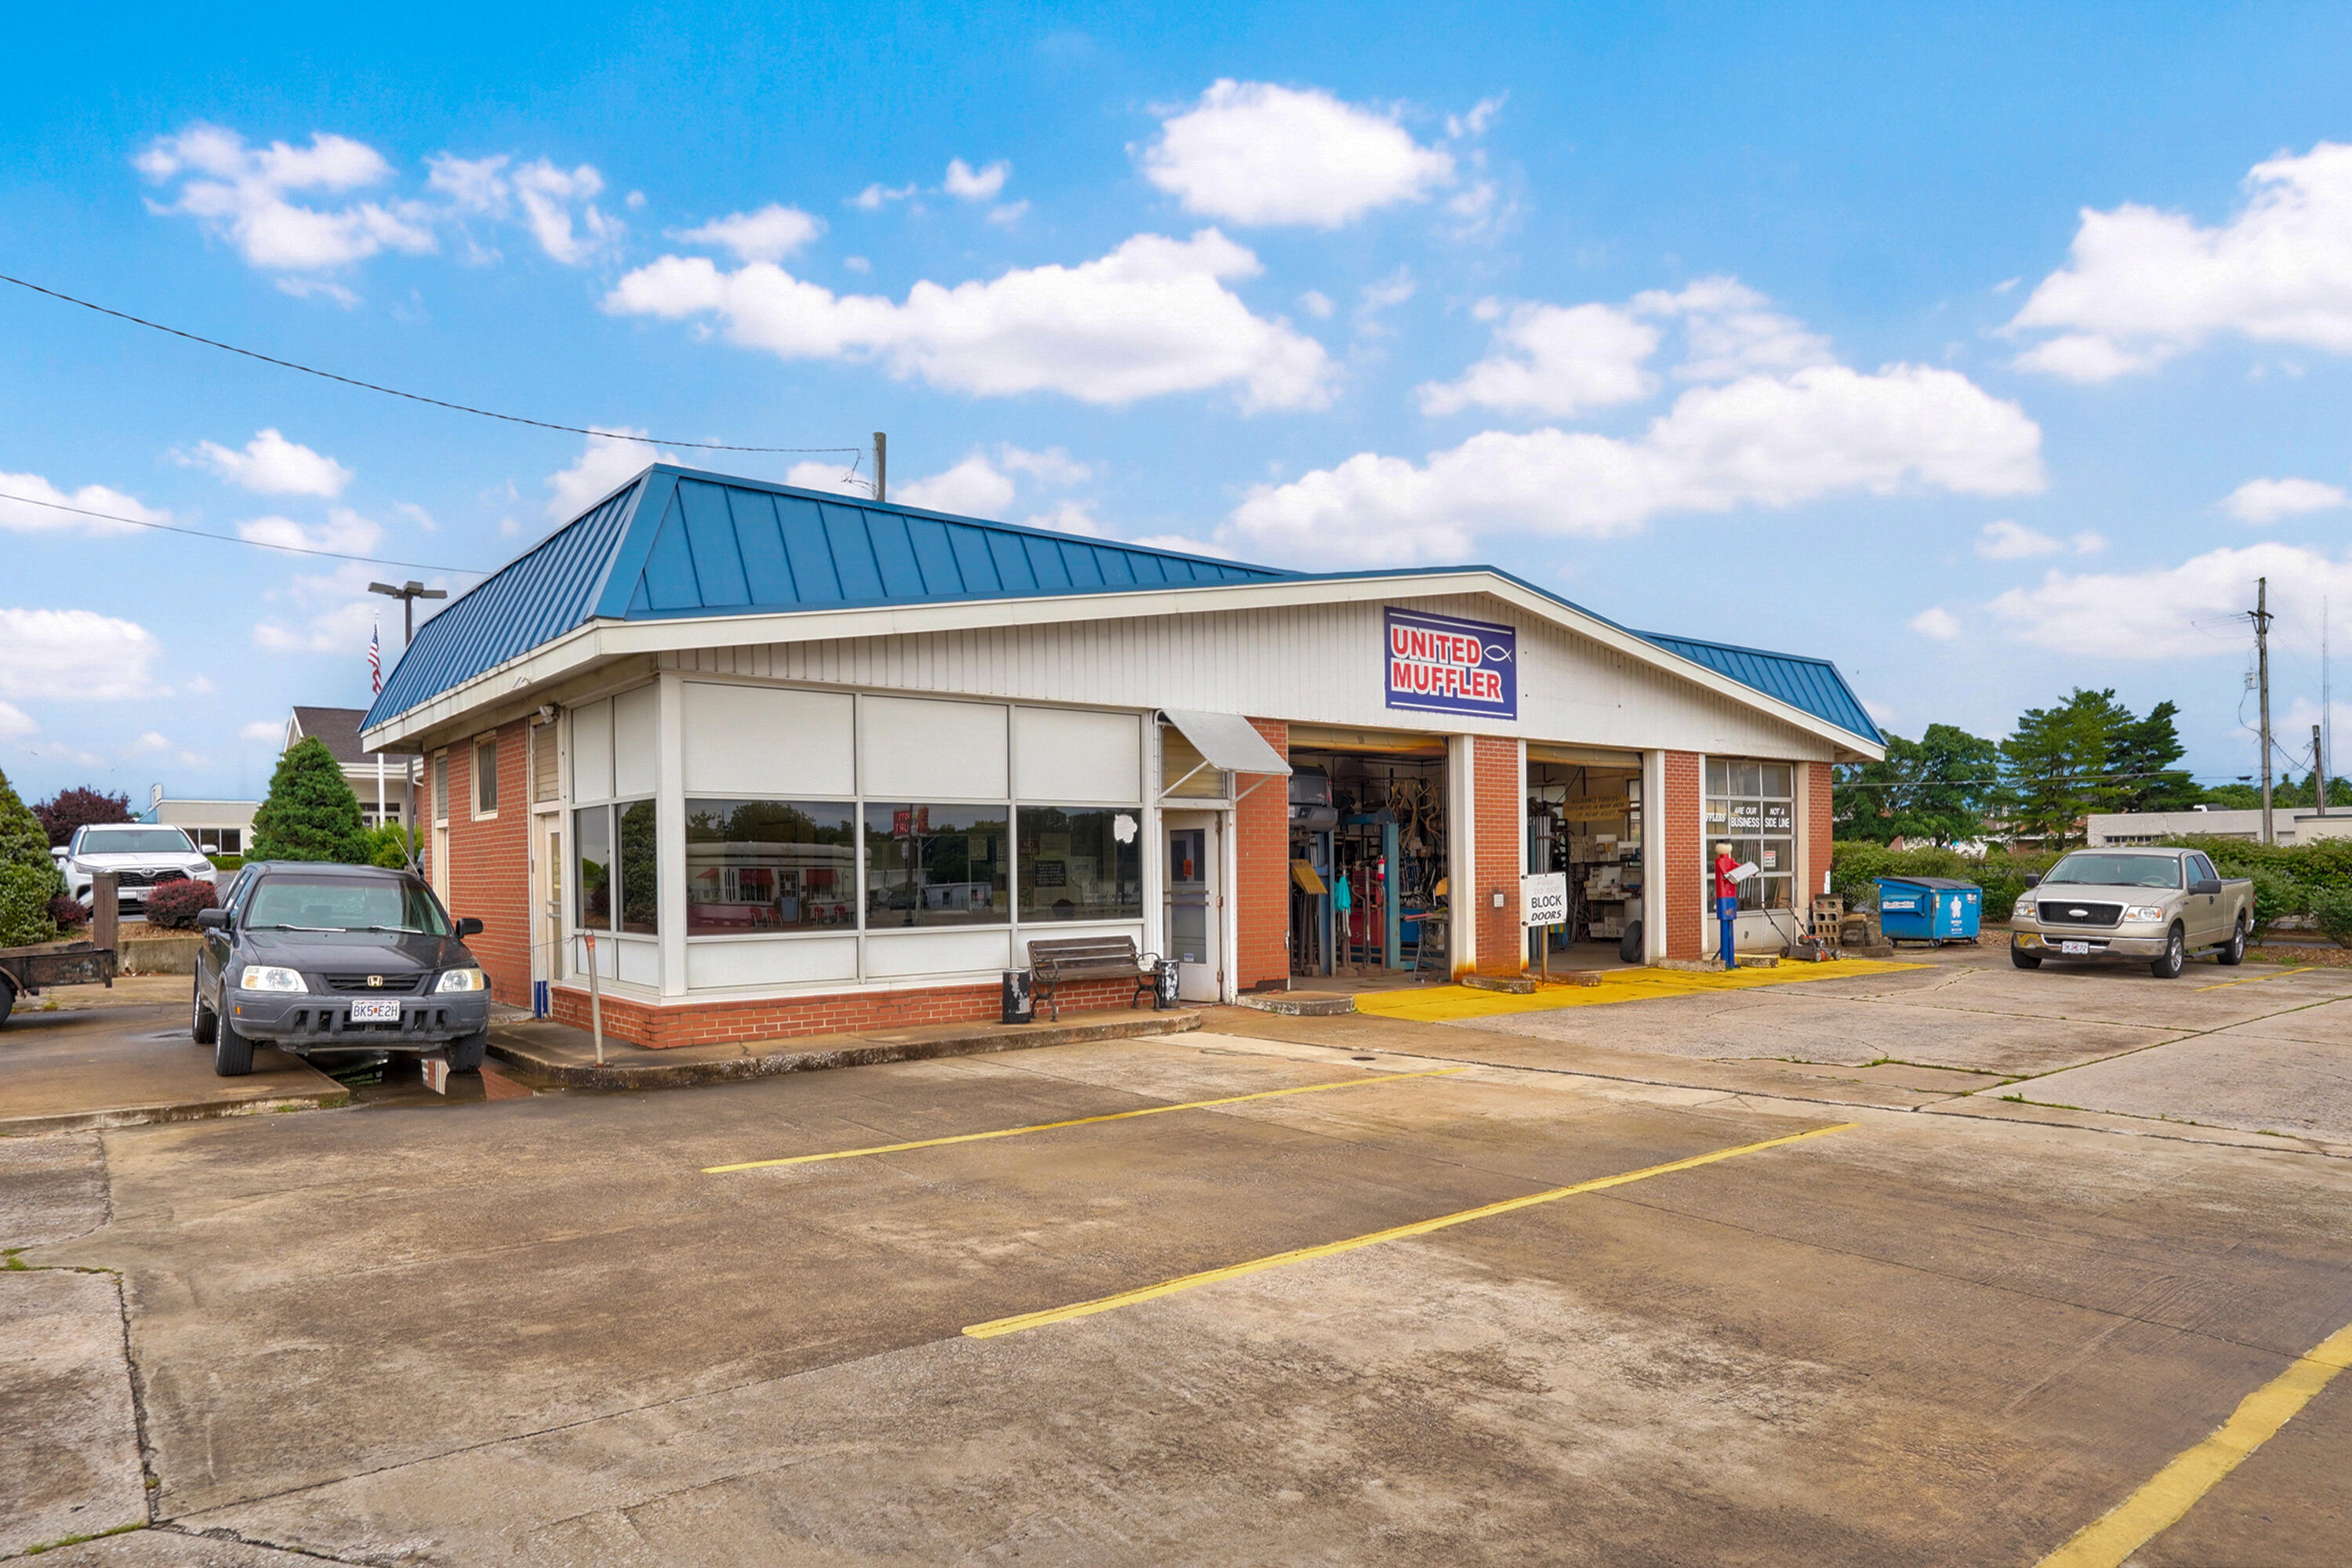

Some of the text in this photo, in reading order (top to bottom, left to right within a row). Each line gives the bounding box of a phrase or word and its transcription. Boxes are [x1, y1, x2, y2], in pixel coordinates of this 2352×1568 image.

[1392, 627, 1481, 665] UNITED
[1392, 661, 1501, 699] MUFFLER
[1730, 817, 1760, 827] BUSINESS
[1764, 818, 1790, 828] SIDE LINE
[1531, 895, 1563, 909] BLOCK
[1531, 909, 1562, 921] DOORS
[353, 1005, 398, 1017] BK5 E2H
